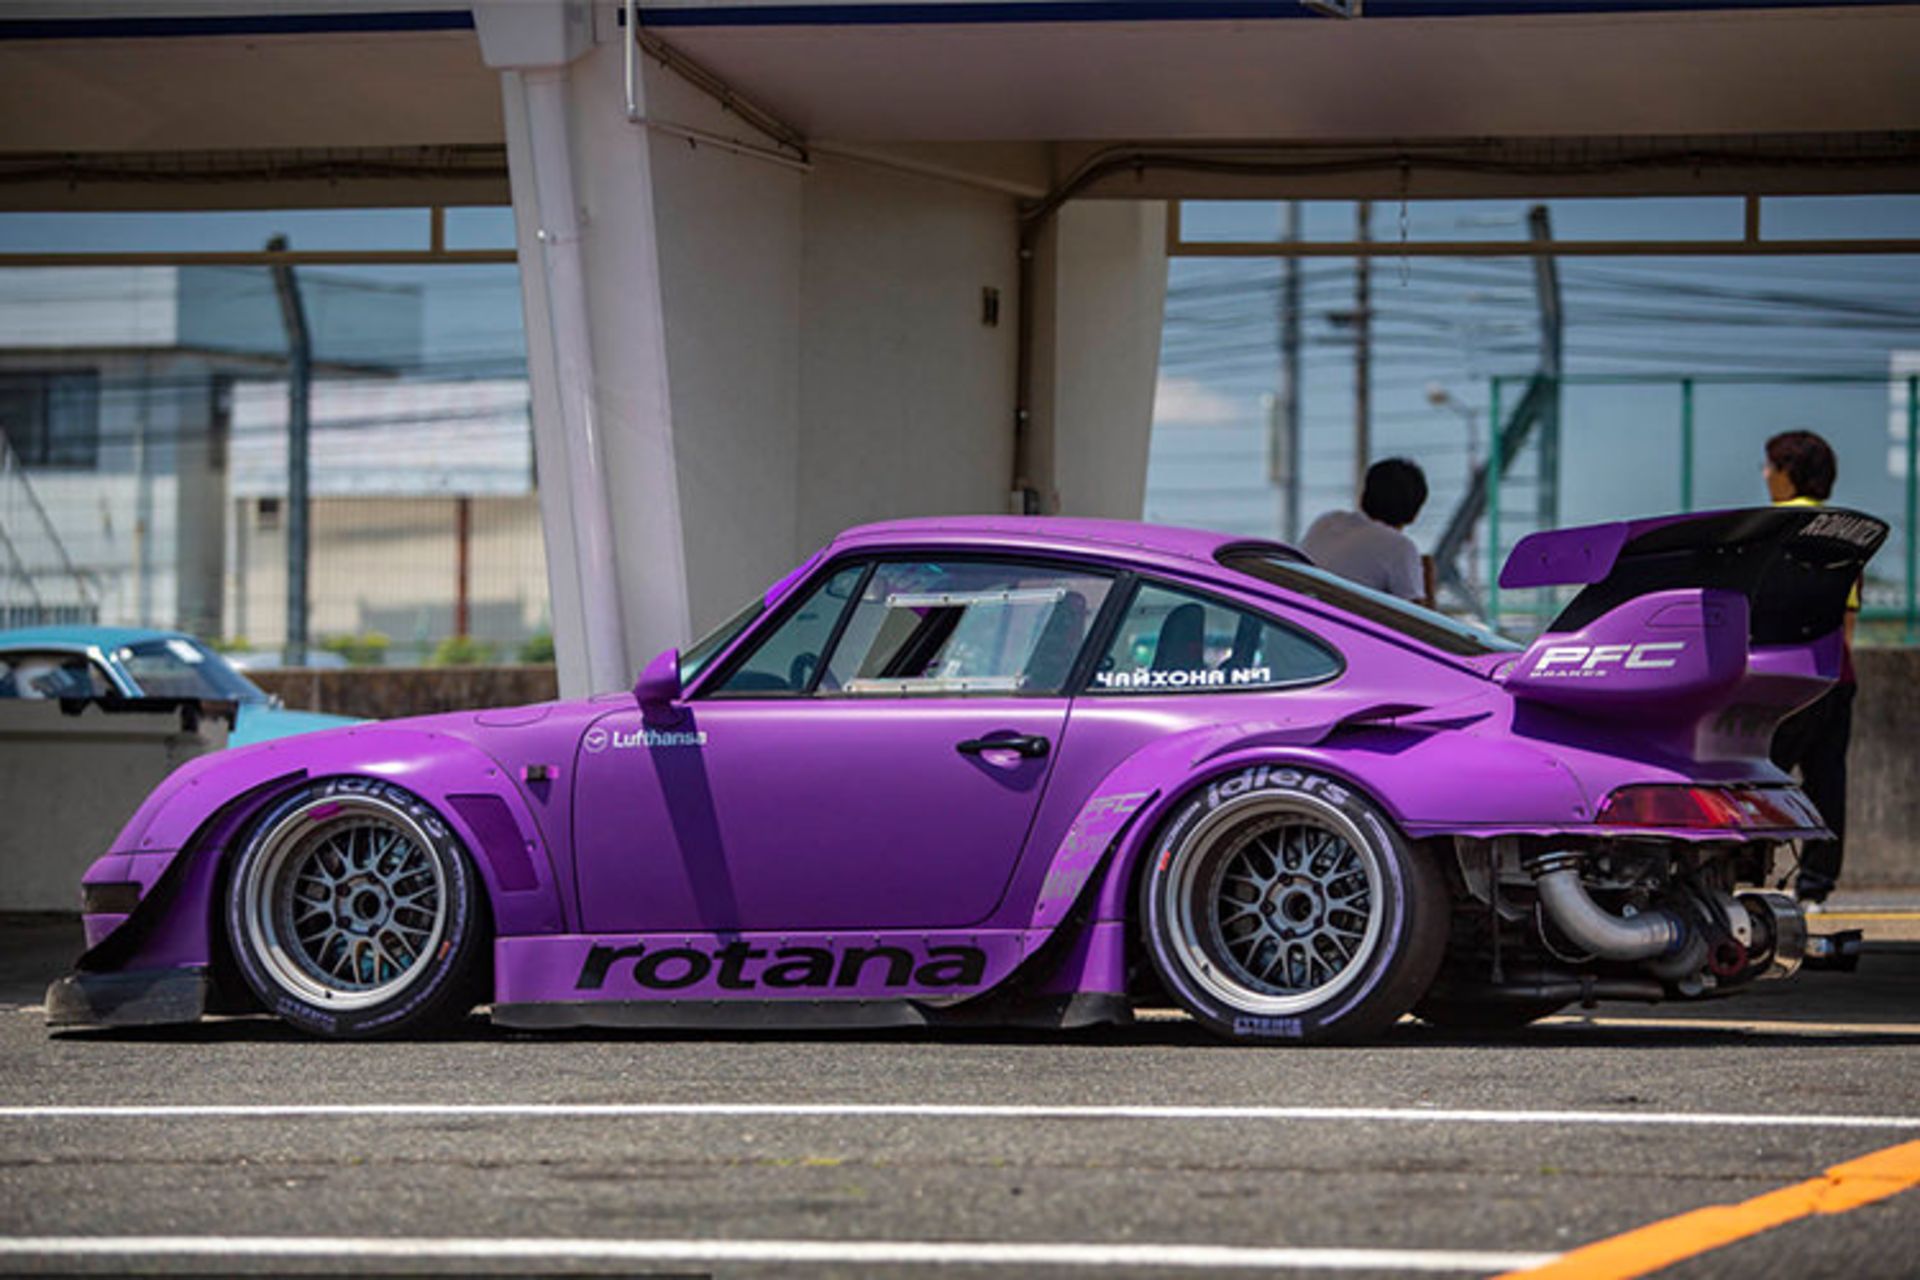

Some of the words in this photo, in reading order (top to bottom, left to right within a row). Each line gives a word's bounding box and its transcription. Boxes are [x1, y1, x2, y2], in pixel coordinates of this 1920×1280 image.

[1534, 642, 1685, 670] PFC
[612, 729, 708, 748] Lufthansa
[574, 941, 987, 991] rotana
